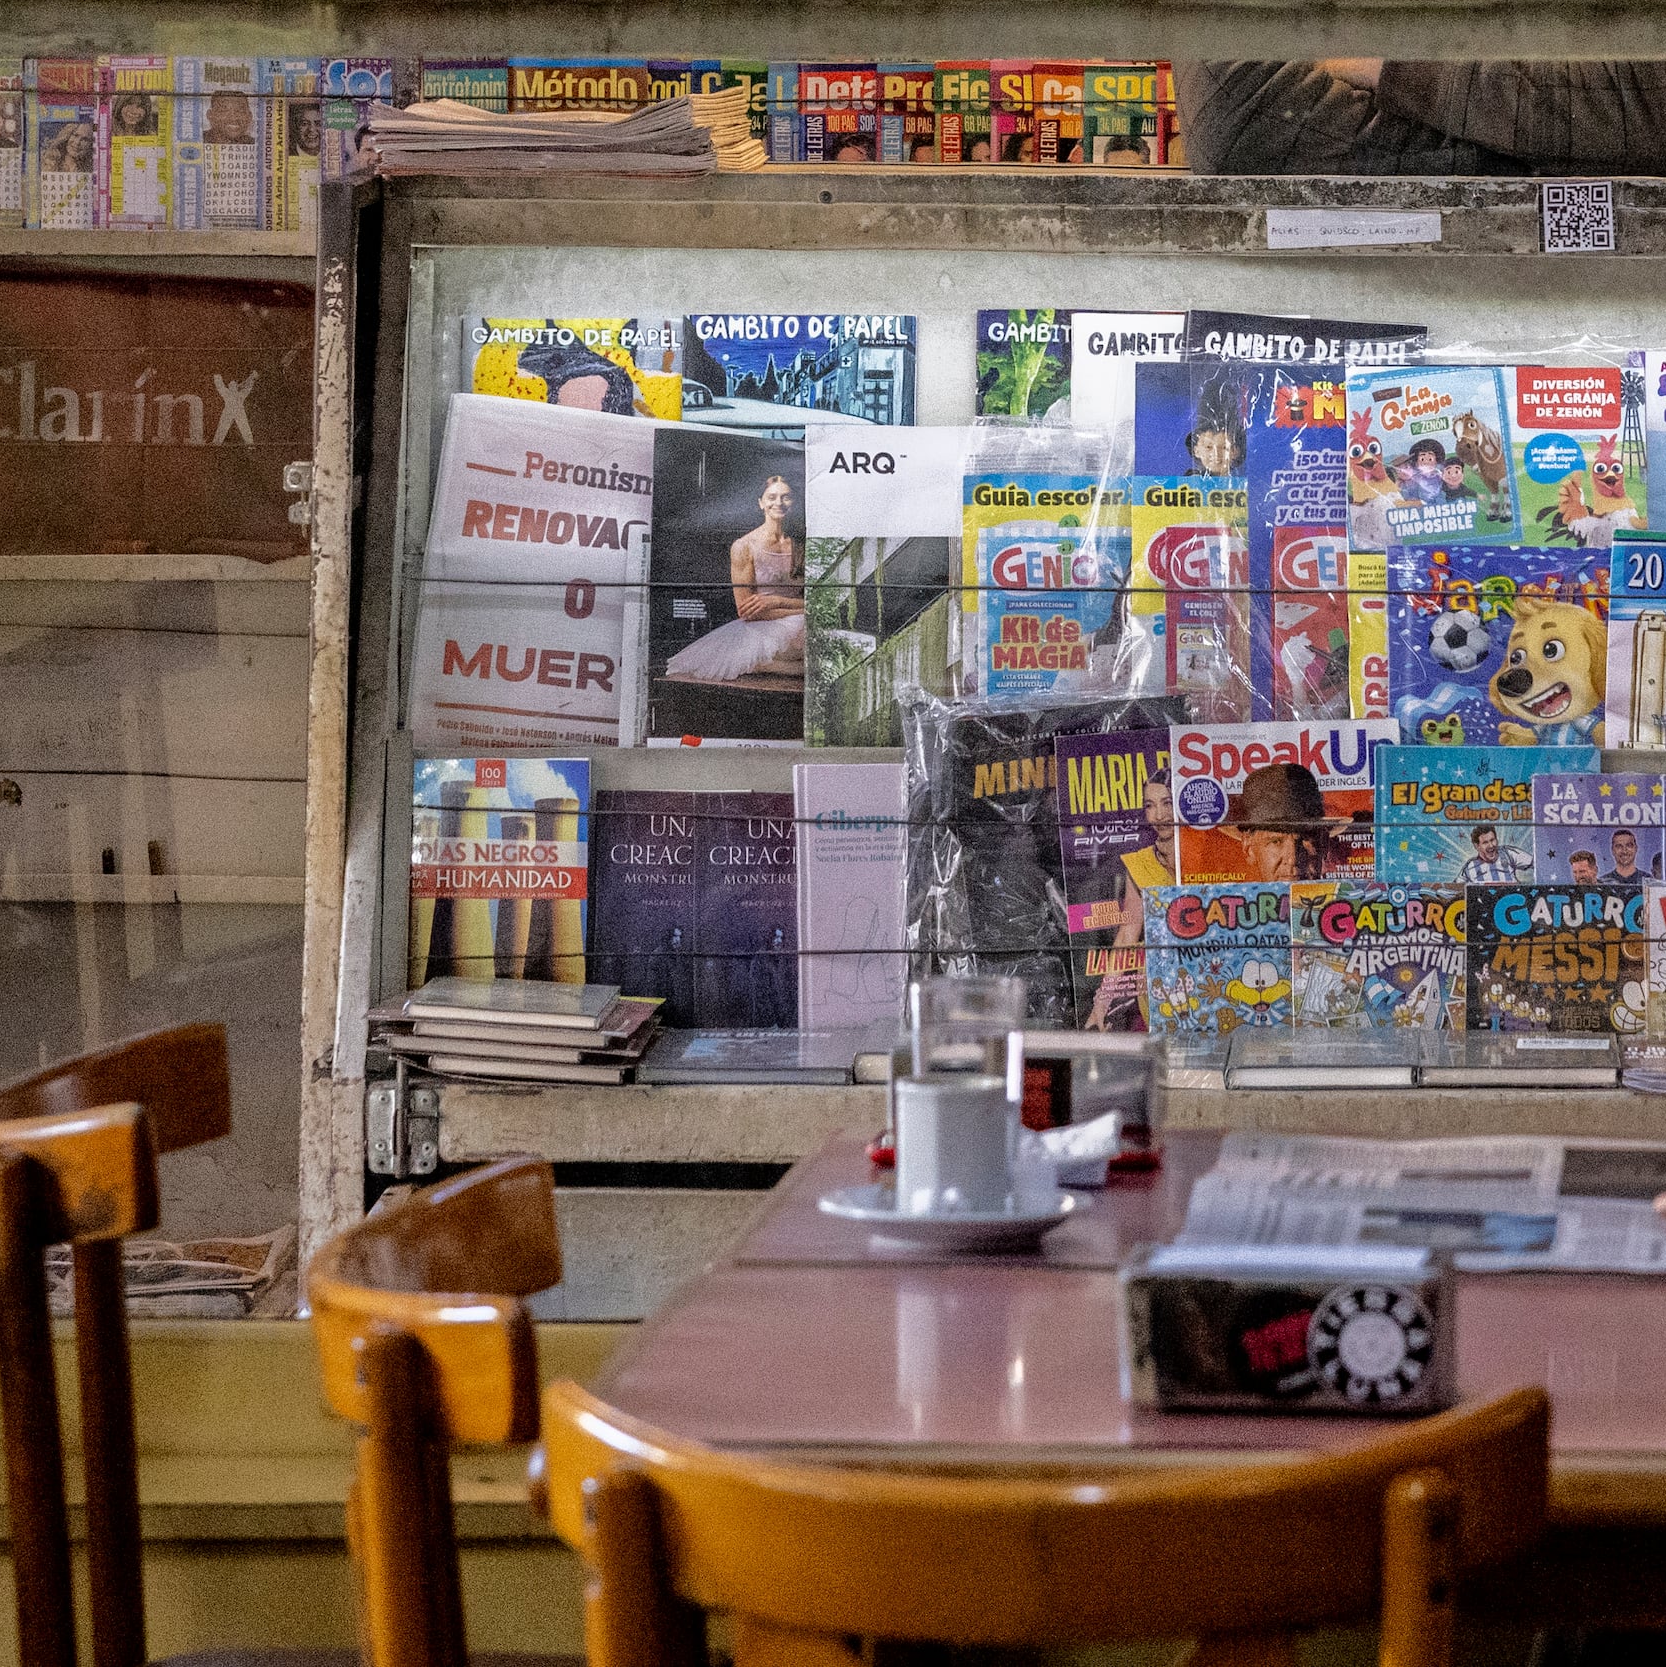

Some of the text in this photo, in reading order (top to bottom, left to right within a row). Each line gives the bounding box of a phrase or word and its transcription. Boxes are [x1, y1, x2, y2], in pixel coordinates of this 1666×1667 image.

[472, 328, 681, 348] GAMBITO DE PAPEL
[696, 315, 909, 340] GAMBITO DE PAPEL
[1205, 331, 1304, 360] GAMBITO
[1314, 337, 1340, 362] DE
[1313, 382, 1334, 391] Kit
[1405, 385, 1431, 405] La
[1533, 377, 1605, 392] DIVERSIÓN
[1523, 391, 1616, 405] EN LA GRANJA
[1380, 393, 1452, 431] Granja
[1536, 404, 1602, 418] DE ZENÓN
[830, 452, 896, 475] ARQ
[974, 486, 1124, 507] Guía escolar
[1146, 487, 1247, 508] Guía esc
[1387, 500, 1477, 525] UNA MISIÓN
[1395, 518, 1474, 536] IMPOSIBLE
[1628, 553, 1665, 591] 20
[563, 578, 596, 619] O
[1001, 617, 1080, 644] Kit de
[994, 644, 1085, 671] MAGIA
[481, 767, 501, 779] 100
[1067, 753, 1148, 814] MARIA
[1391, 783, 1418, 806] El
[1422, 782, 1480, 814] gran
[1551, 783, 1578, 800] LA
[1543, 803, 1662, 825] SCALON
[1074, 833, 1139, 846] RIVER
[474, 843, 559, 863] NEGROS
[611, 844, 692, 865] CREAC
[436, 869, 572, 889] HUMANIDAD
[1184, 873, 1246, 881] SCIENTIFICALLY
[1320, 899, 1466, 943] GATURRO
[1493, 894, 1644, 935] GATURRO
[1346, 946, 1466, 976] ARGENTINA
[1492, 930, 1620, 982] MESSI
